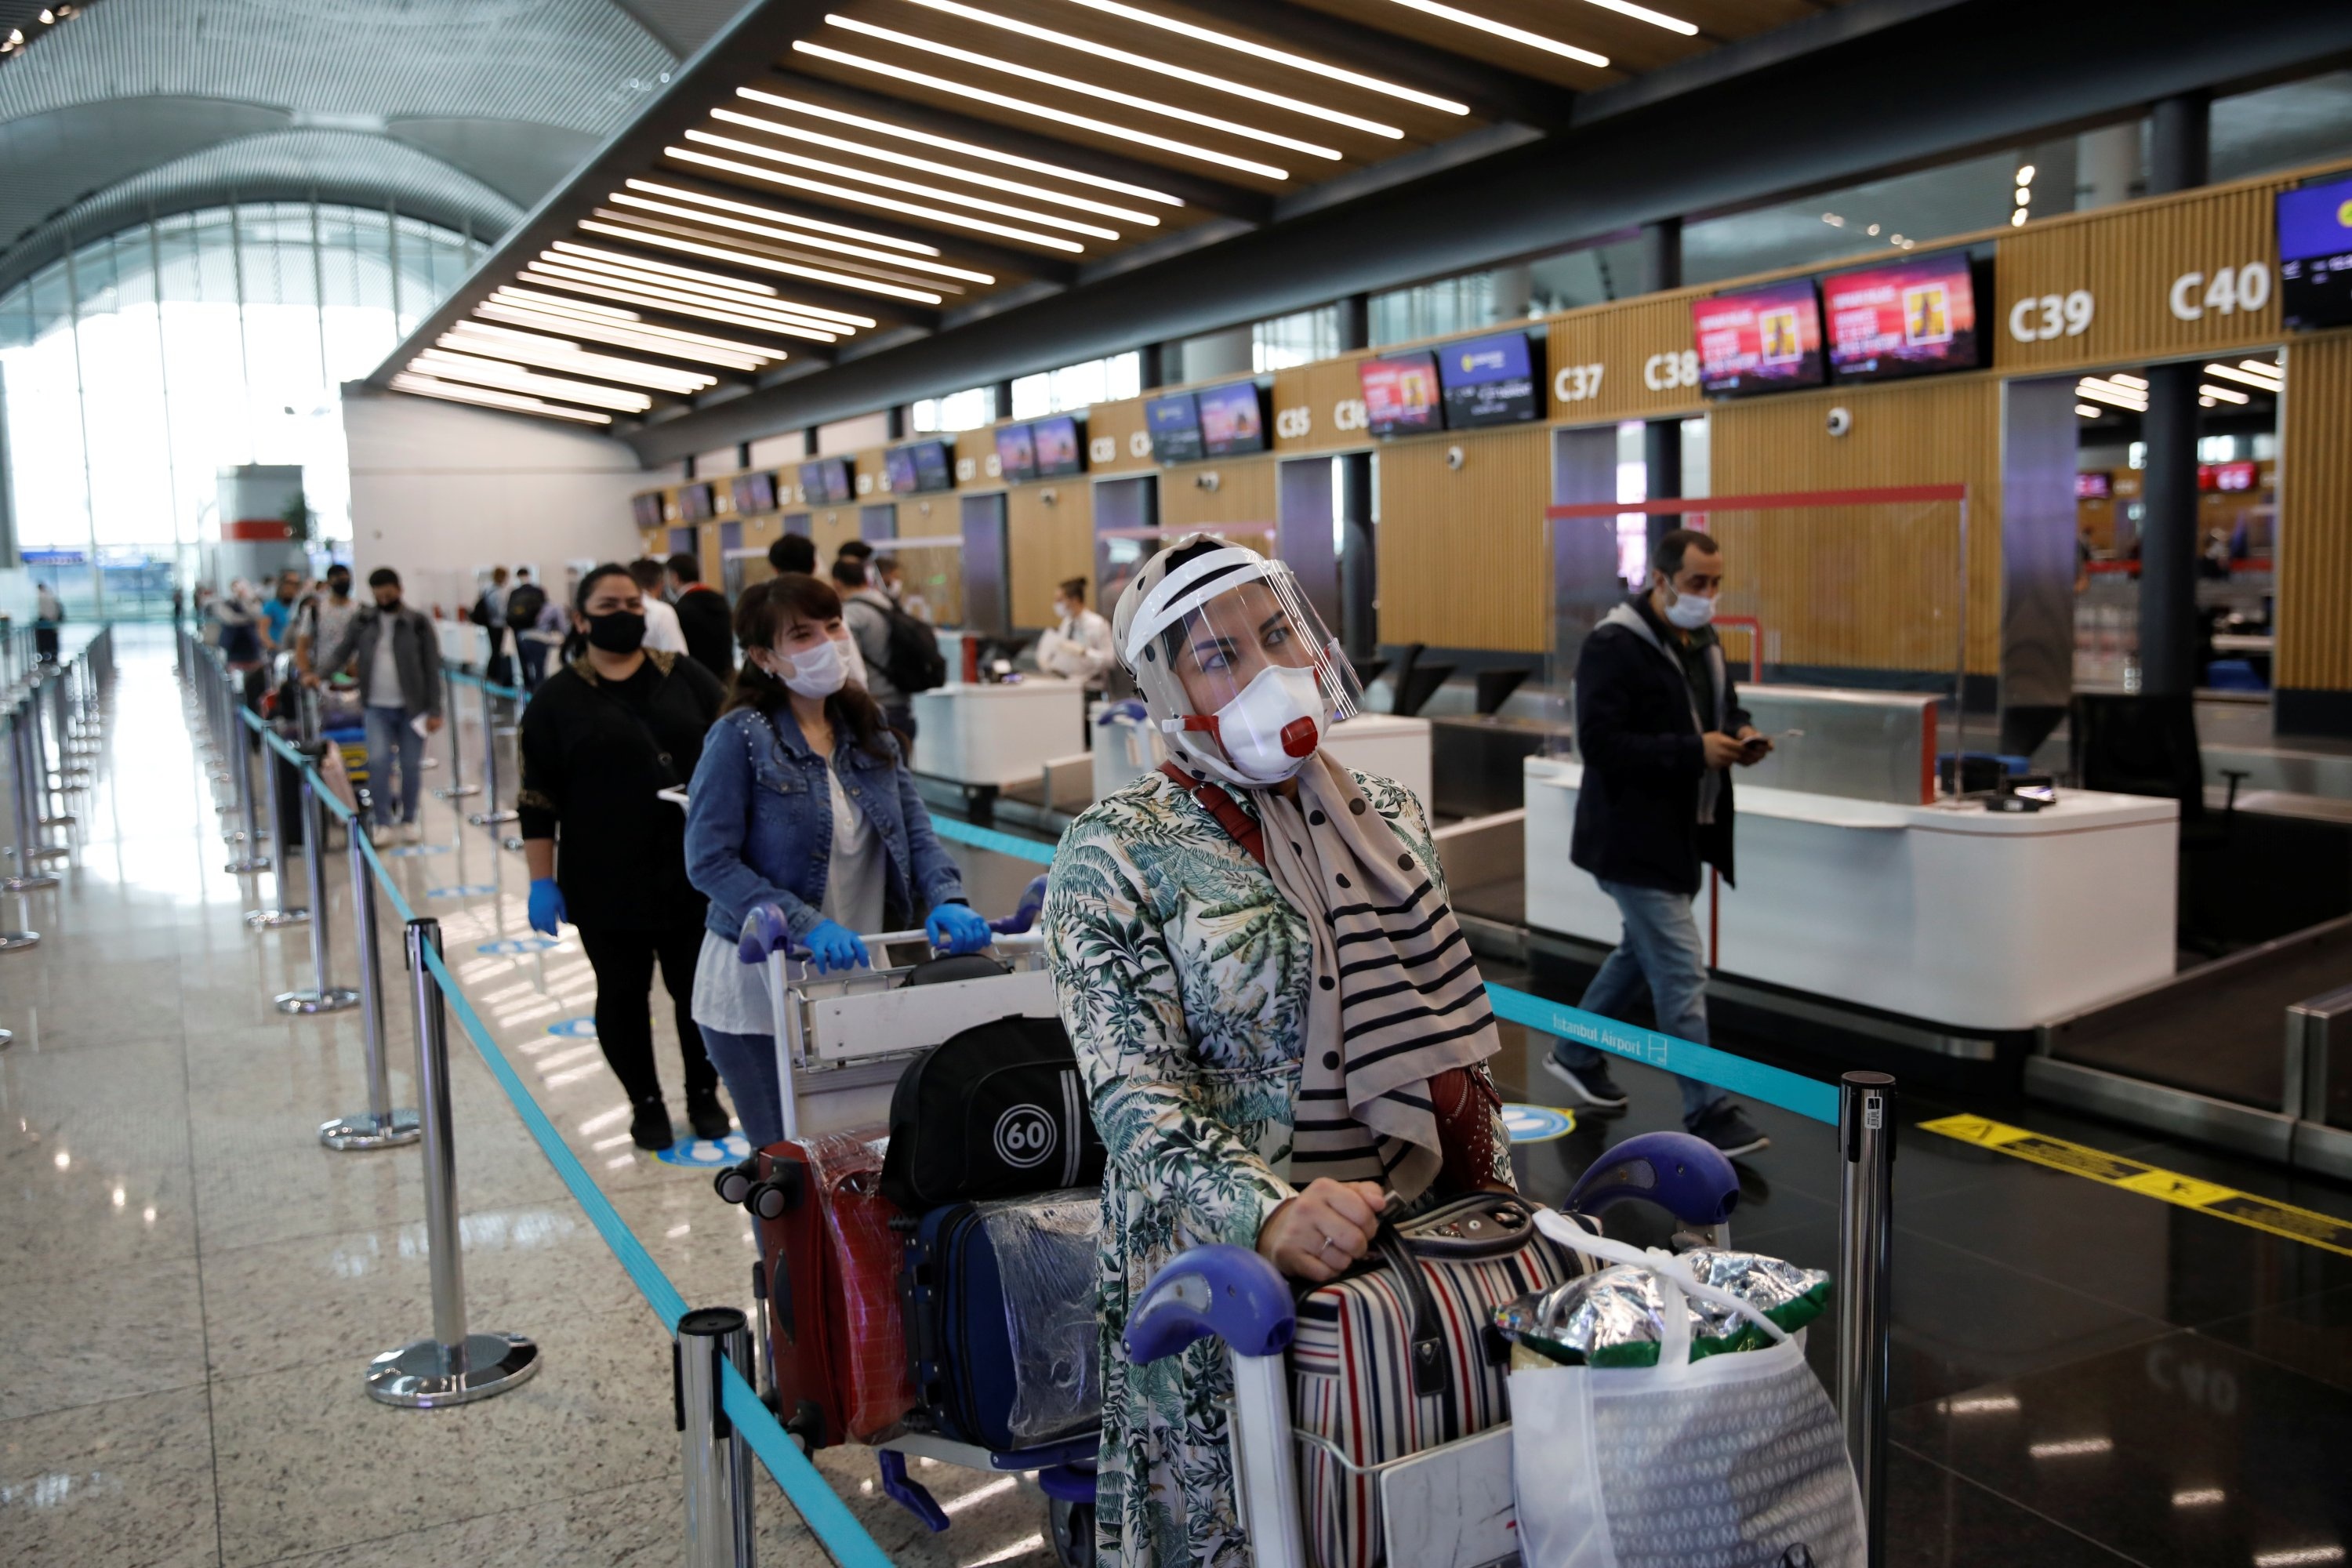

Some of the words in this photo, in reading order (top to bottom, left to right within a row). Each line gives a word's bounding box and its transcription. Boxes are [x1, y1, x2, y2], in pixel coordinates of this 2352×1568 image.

[2170, 262, 2270, 321] C40
[2009, 289, 2094, 343] C39
[1555, 363, 1604, 402] C37
[1644, 349, 1700, 392] C38
[1552, 1013, 1598, 1042] Istanbul
[1601, 1029, 1641, 1055] Airport
[1007, 1121, 1045, 1149] 60
